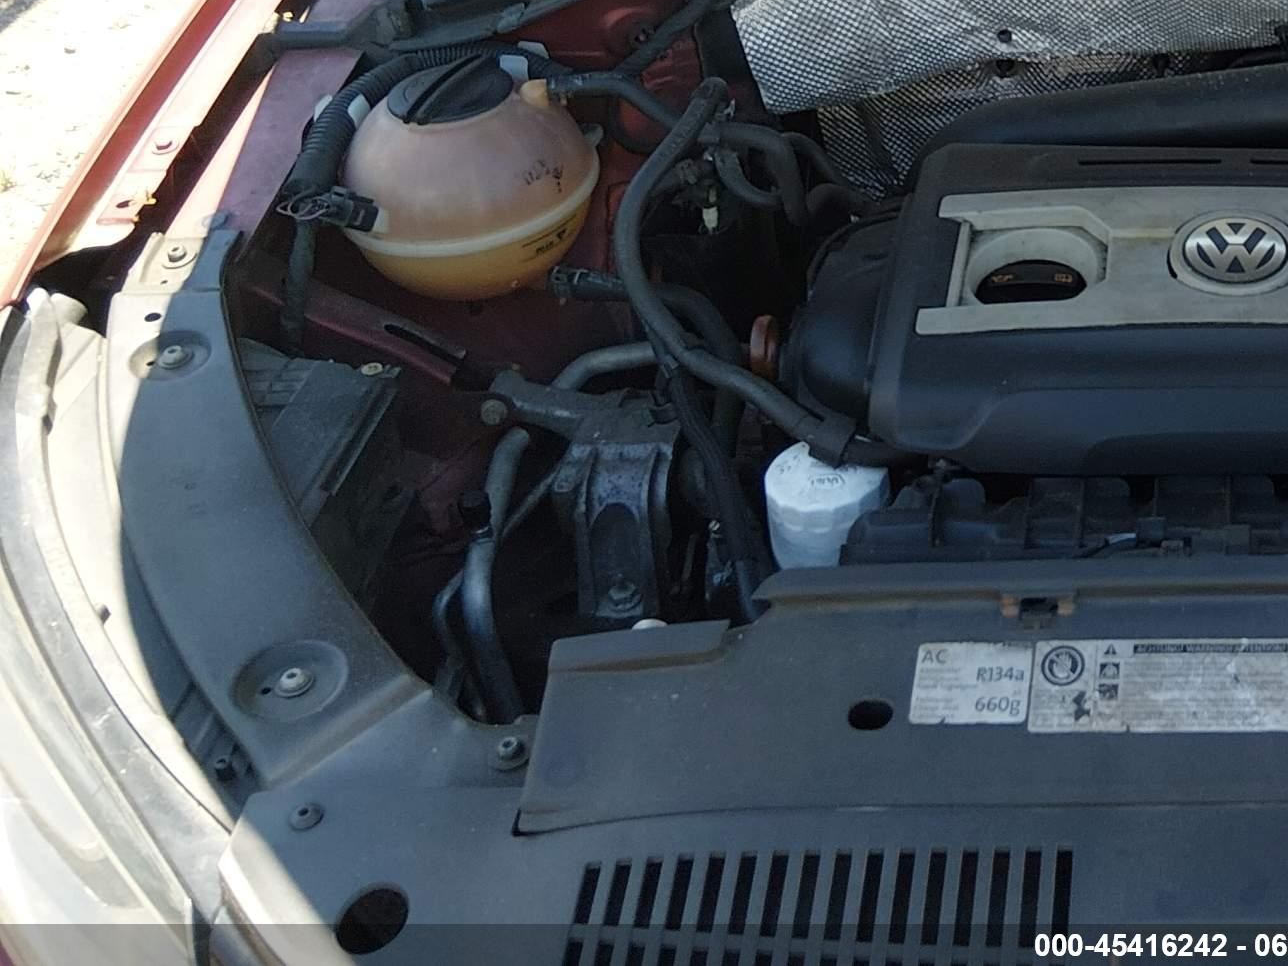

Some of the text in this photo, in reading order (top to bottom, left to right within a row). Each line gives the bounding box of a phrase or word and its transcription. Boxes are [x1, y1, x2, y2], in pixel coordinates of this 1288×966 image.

[921, 648, 948, 665] AC
[976, 666, 1025, 683] R134a
[975, 696, 1022, 717] 660g
